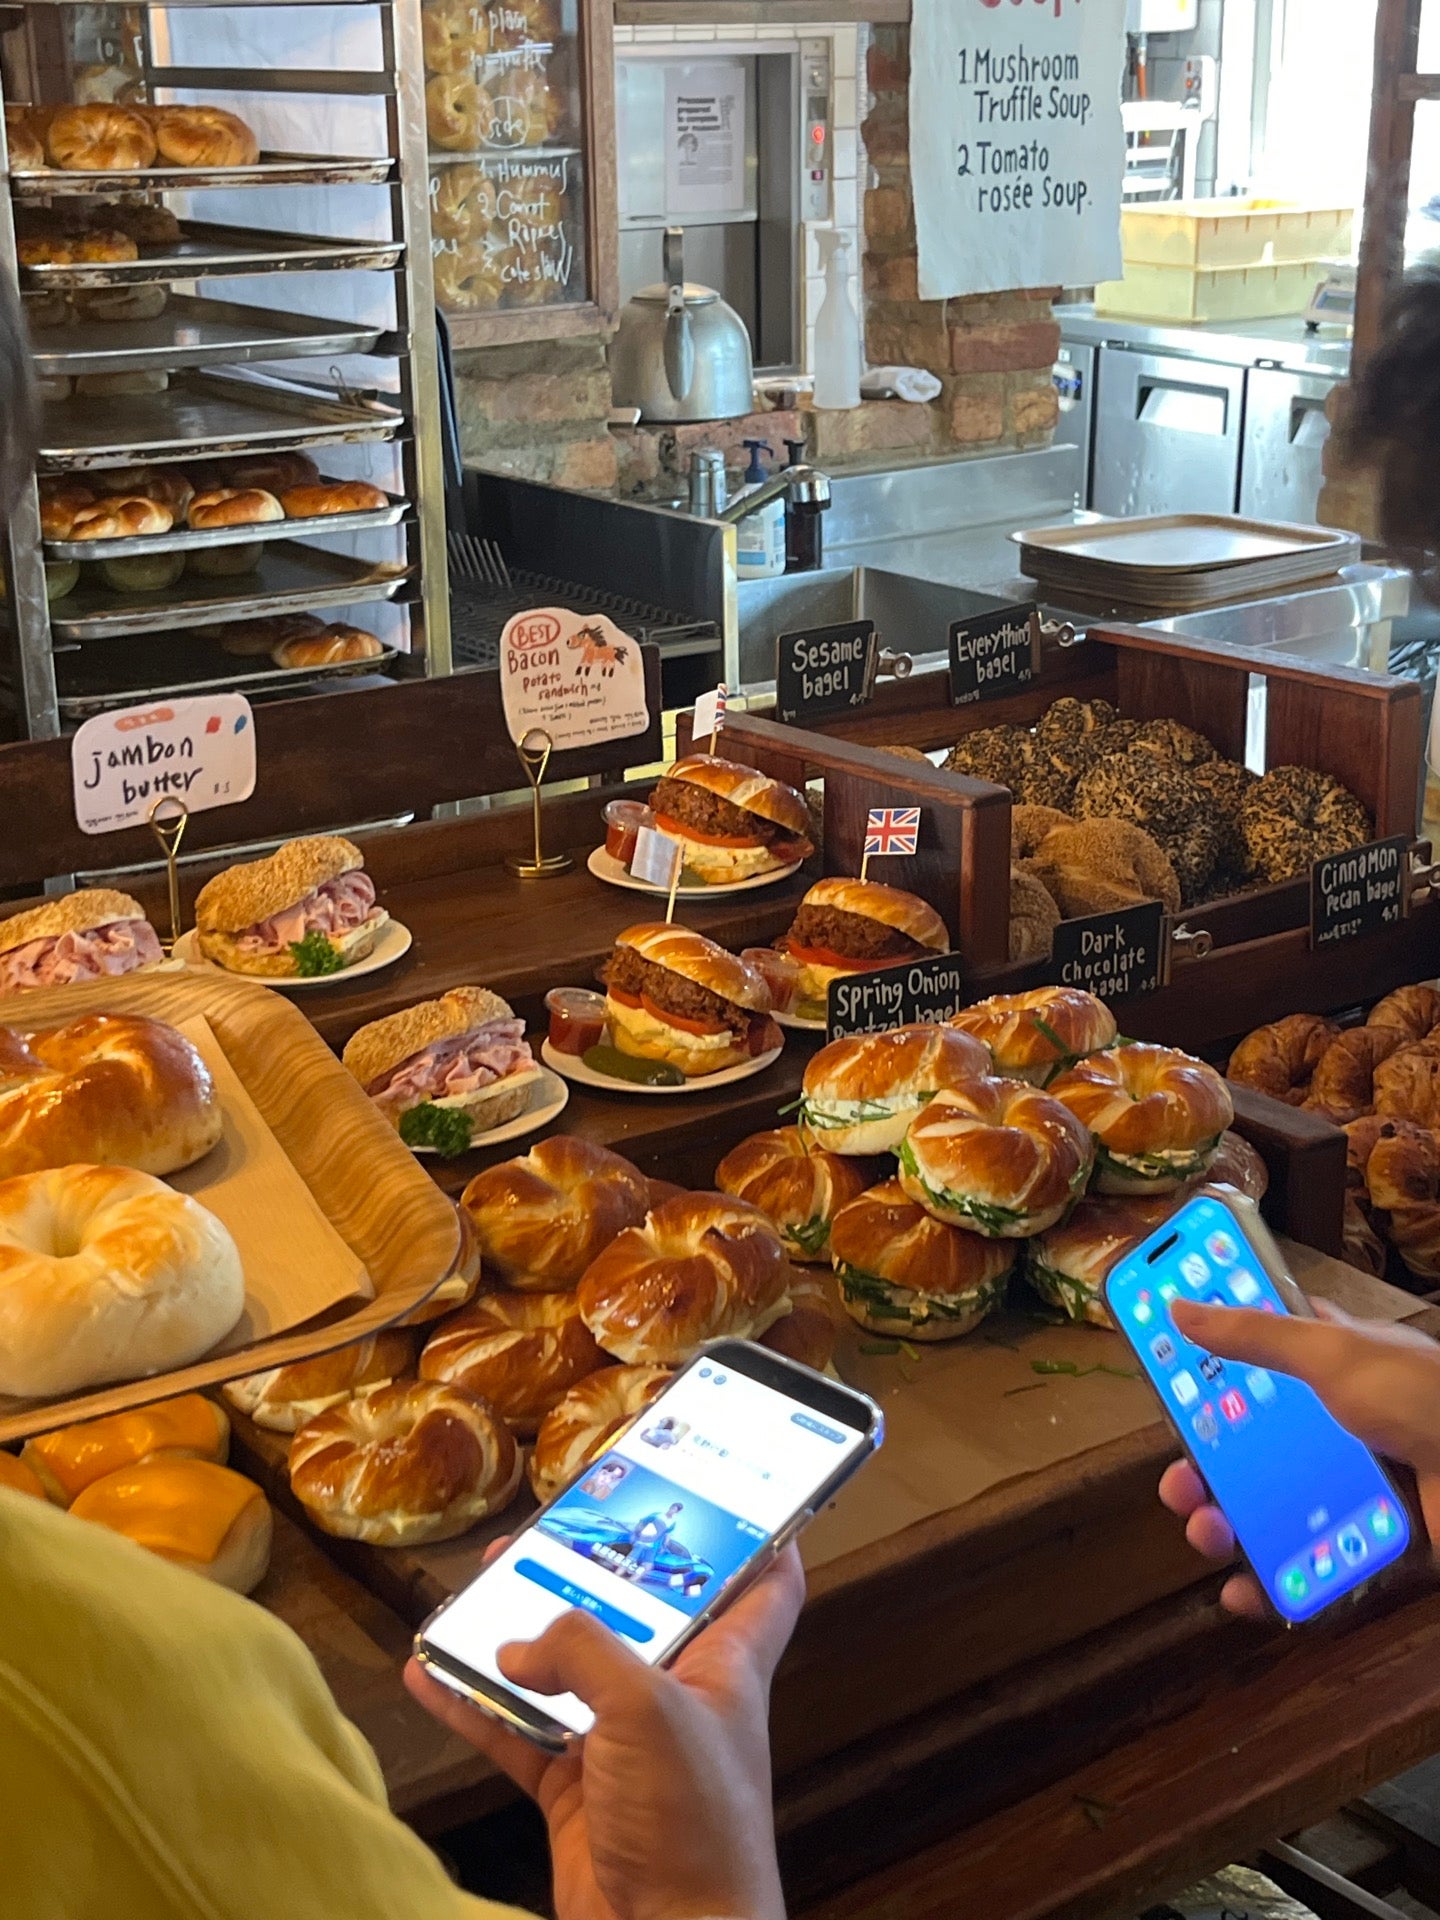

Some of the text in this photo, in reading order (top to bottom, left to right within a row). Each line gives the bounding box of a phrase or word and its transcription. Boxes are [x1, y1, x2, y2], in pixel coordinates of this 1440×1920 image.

[488, 7, 528, 47] plain
[973, 44, 1079, 84] Mushroom
[974, 86, 1042, 123] Truffle
[976, 140, 1049, 174] Tomato
[978, 175, 1033, 212] rosée
[517, 624, 552, 647] BEST
[956, 621, 1032, 662] Everything
[507, 648, 560, 675] Bacon
[792, 637, 863, 672] Sesame
[976, 652, 1016, 683] bagel
[522, 673, 561, 694] potato
[802, 666, 849, 699] bagel
[84, 735, 193, 789] jambon
[122, 767, 203, 805] butter
[1366, 872, 1401, 902] bagel
[1081, 924, 1126, 956] Dark
[1062, 946, 1145, 984] Chocolate
[836, 966, 960, 1023] Spring Onion
[1089, 972, 1129, 997] bagel
[832, 1008, 904, 1040] Ptzel
